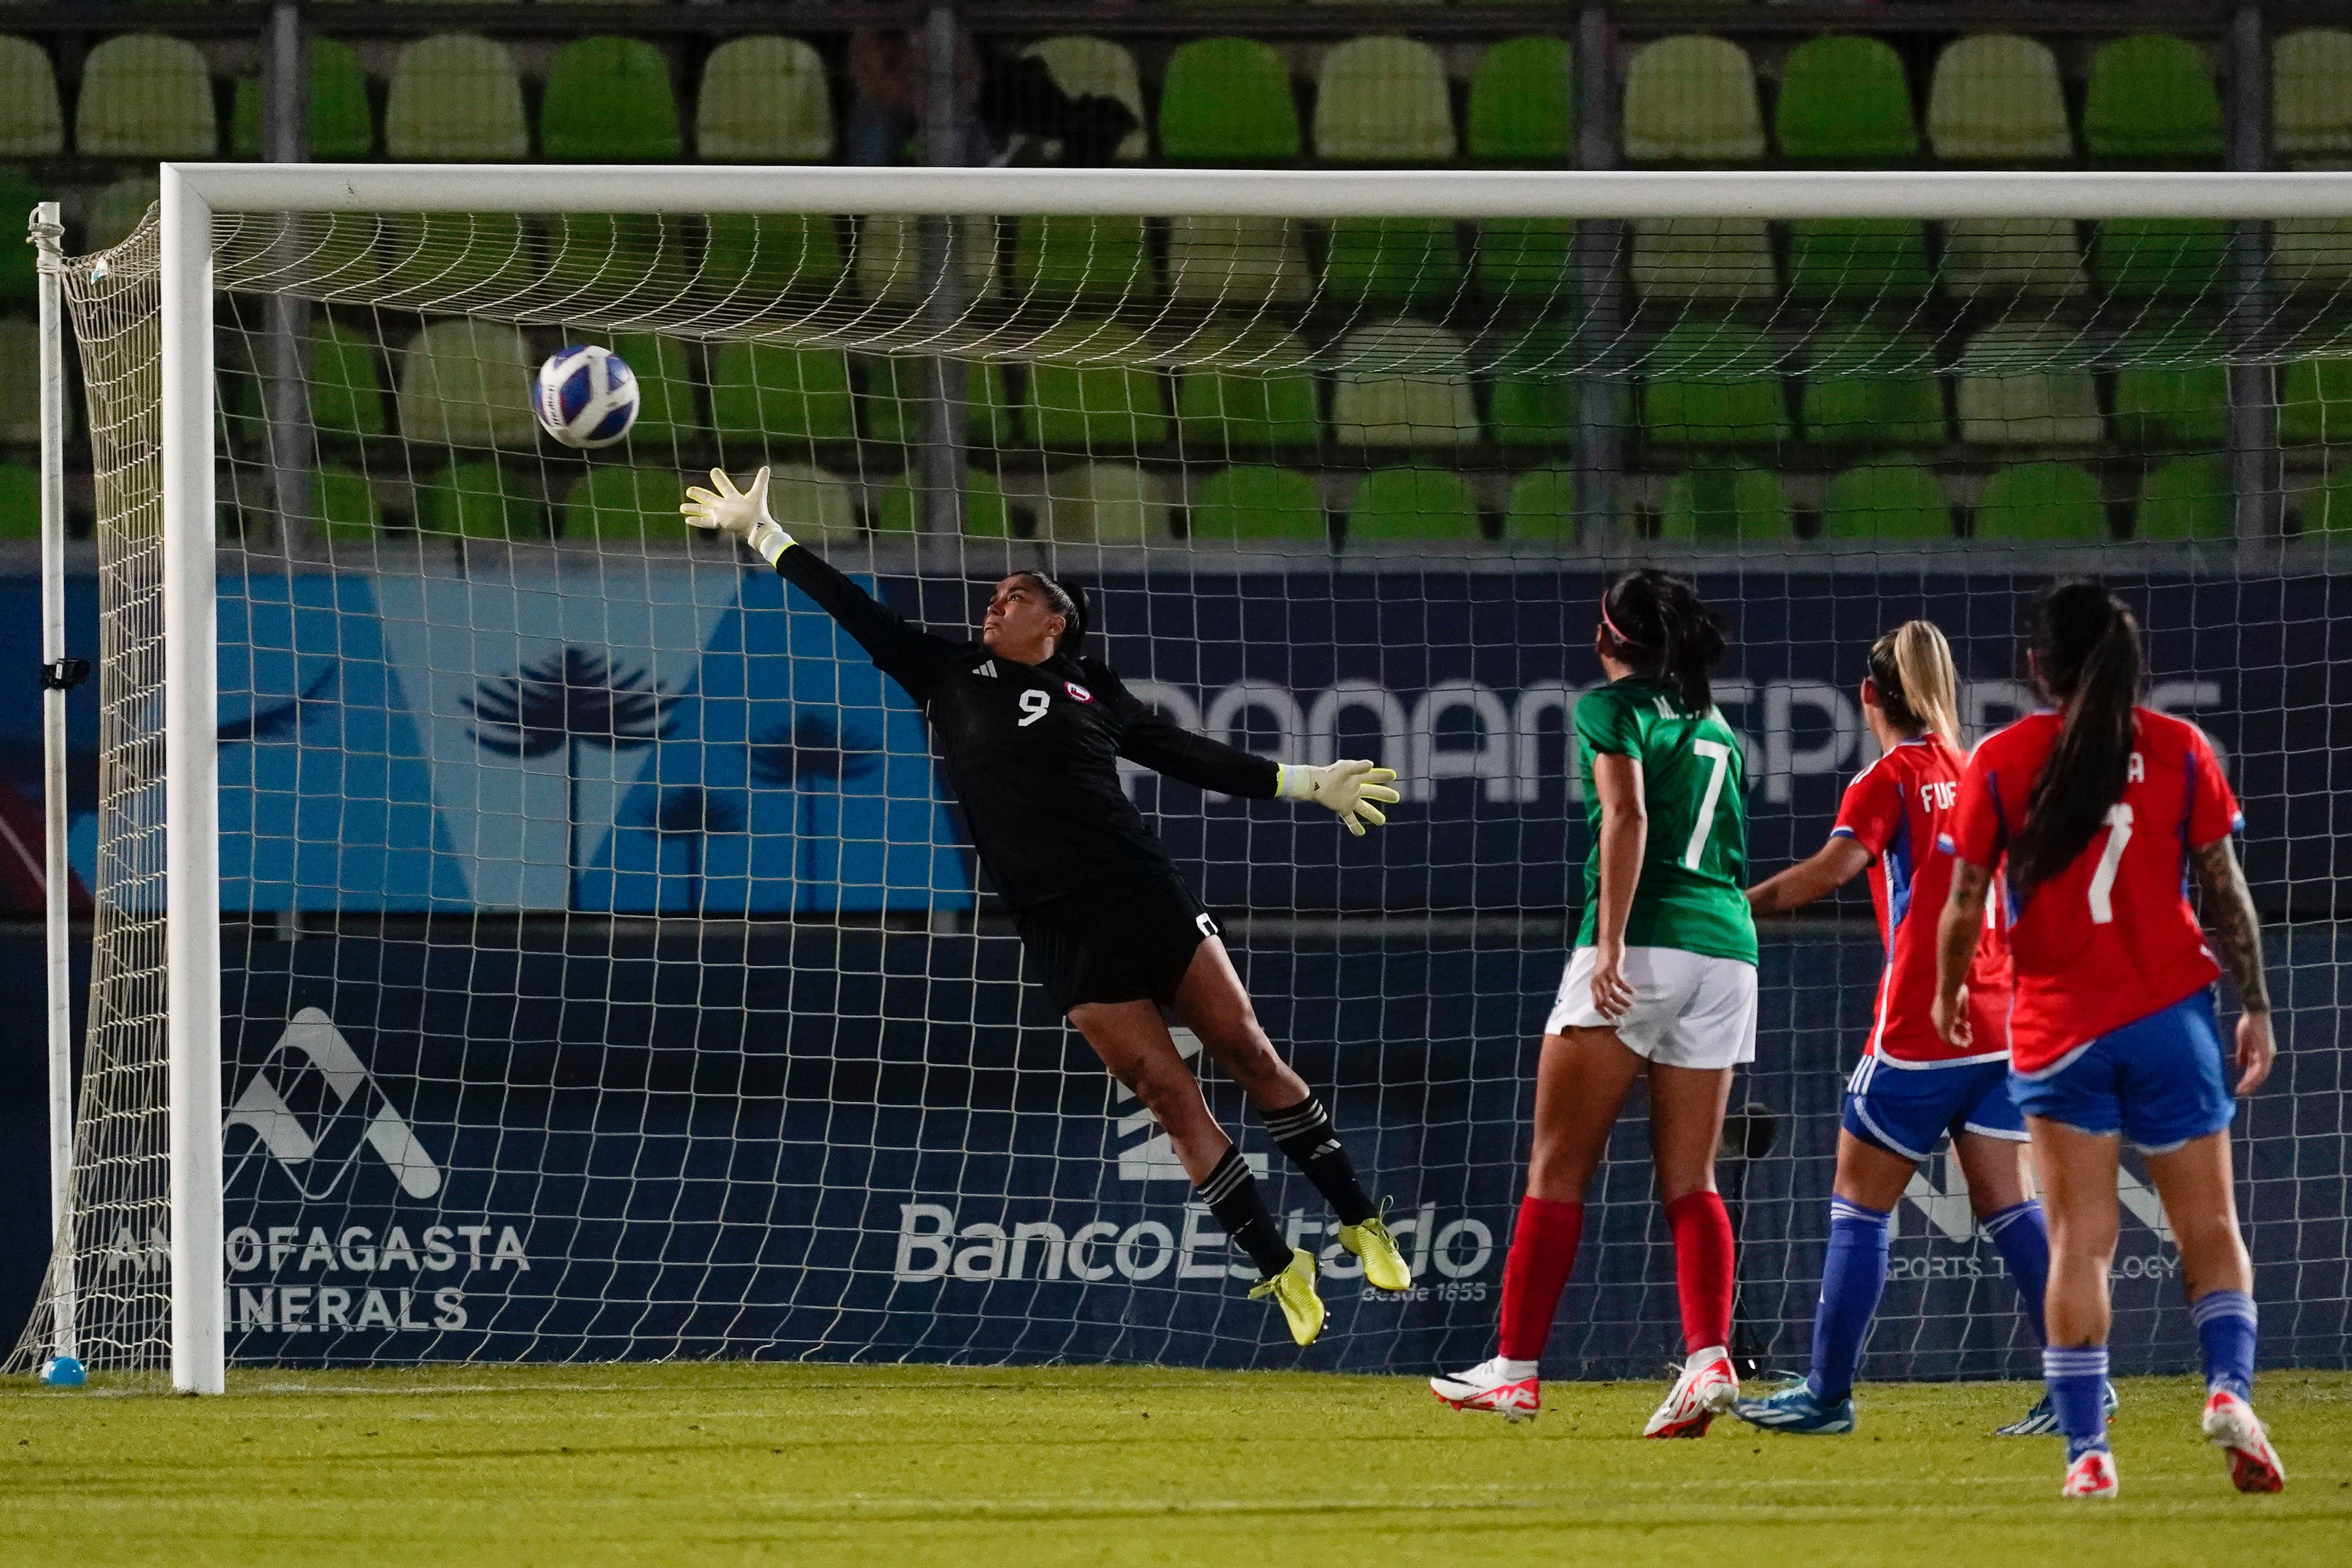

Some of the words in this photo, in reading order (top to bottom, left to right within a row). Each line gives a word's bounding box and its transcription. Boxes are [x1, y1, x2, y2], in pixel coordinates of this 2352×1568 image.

[1018, 689, 1050, 726] 9
[1685, 739, 1732, 871] 7
[109, 1226, 531, 1272] ANOFAGASTA
[1887, 1256, 1982, 1279] PORTS
[223, 1286, 468, 1333] INERALS
[1436, 1281, 1487, 1301] 1855
